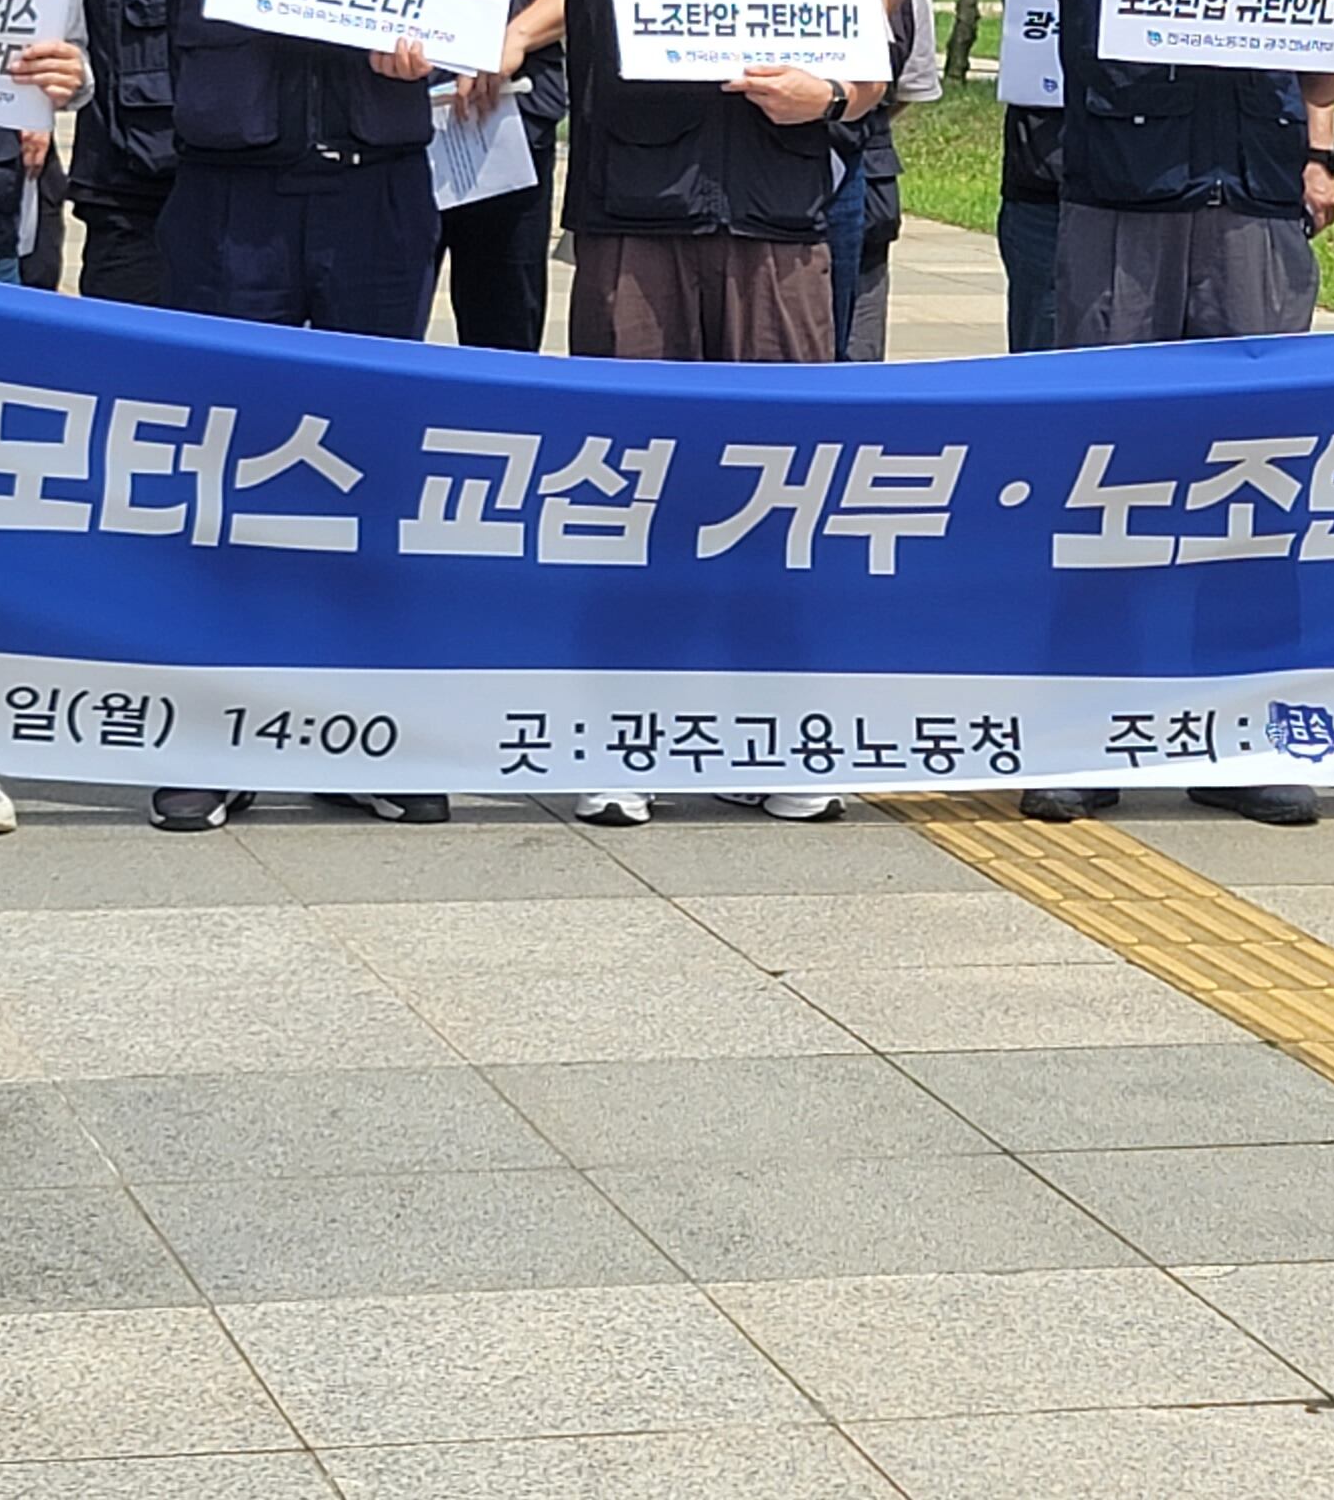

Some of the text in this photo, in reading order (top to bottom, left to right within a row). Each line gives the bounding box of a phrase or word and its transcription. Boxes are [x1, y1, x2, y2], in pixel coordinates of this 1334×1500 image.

[633, 2, 859, 38] 노조탄압 규탄한다!
[398, 426, 676, 567] 교섭
[696, 443, 969, 576] 거부
[223, 705, 399, 758] 14:00
[607, 711, 1023, 776] 광주고용노동청
